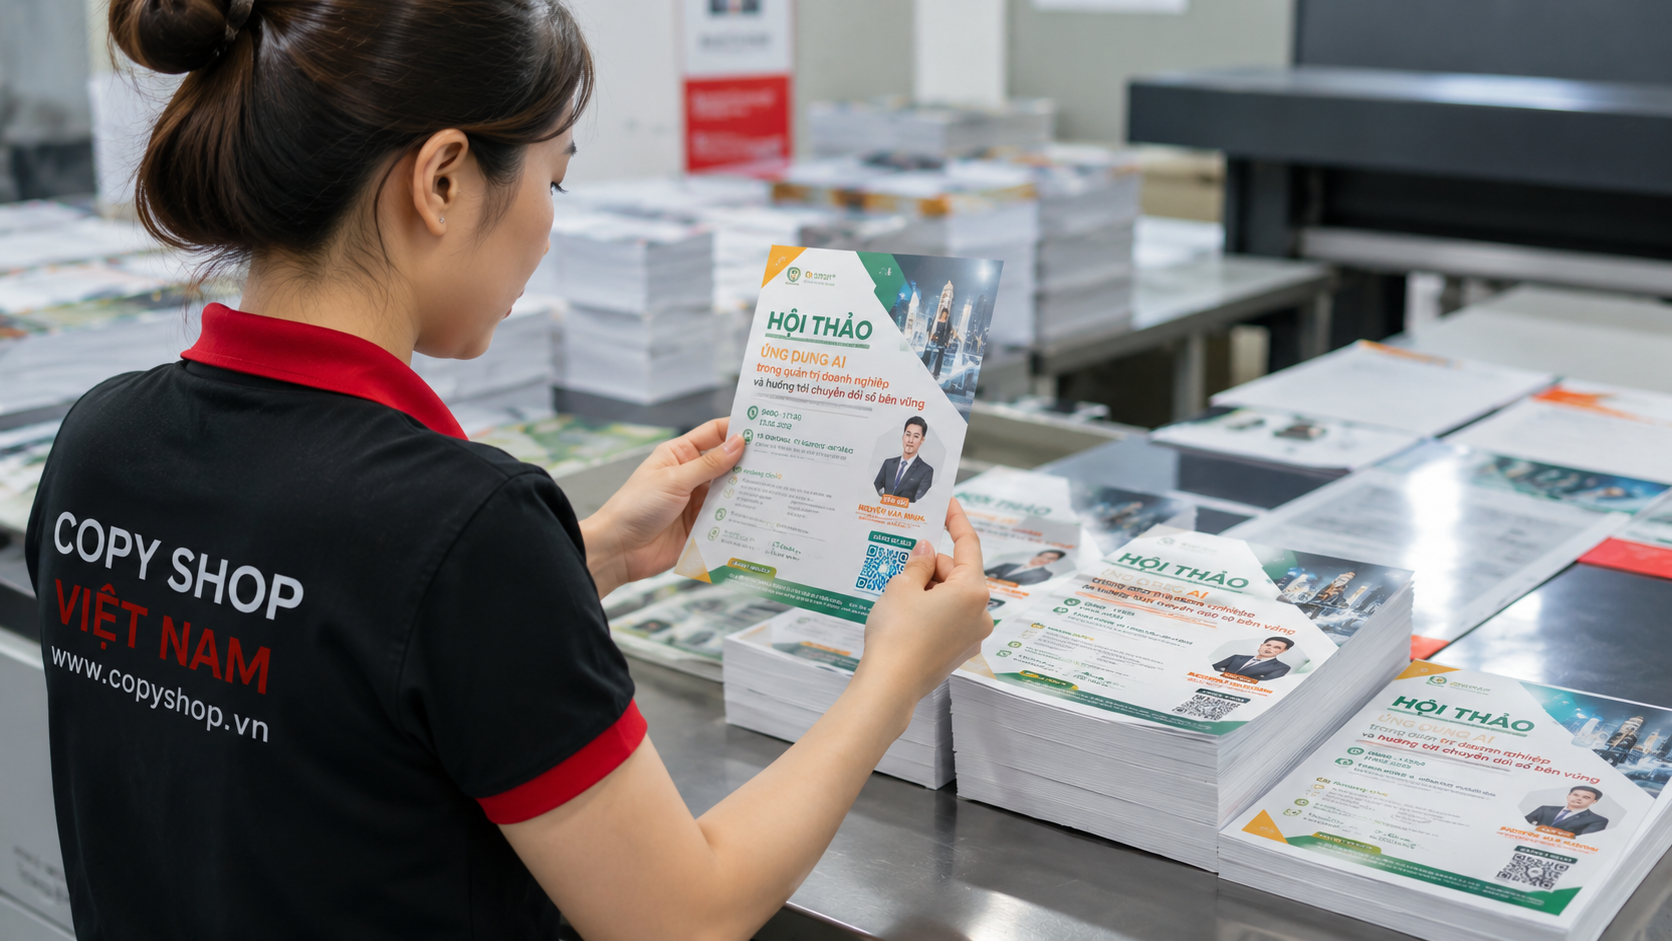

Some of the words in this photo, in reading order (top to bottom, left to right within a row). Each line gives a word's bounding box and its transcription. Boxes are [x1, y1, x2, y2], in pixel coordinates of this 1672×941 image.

[767, 308, 807, 338] HỘI
[812, 312, 873, 341] THẢO
[756, 362, 782, 377] trong
[822, 371, 852, 384] doanh
[831, 355, 847, 368] AI
[54, 511, 162, 581] COPY
[167, 546, 304, 620] SHOP
[1117, 552, 1170, 572] HỘI
[1174, 564, 1249, 588] THẢO
[1186, 590, 1209, 599] AI
[55, 578, 149, 650] VIỆT
[159, 615, 271, 695] NAM
[51, 645, 269, 743] www.copyshop.vn
[1391, 695, 1448, 716] HỘI
[1454, 707, 1535, 732] THẢO
